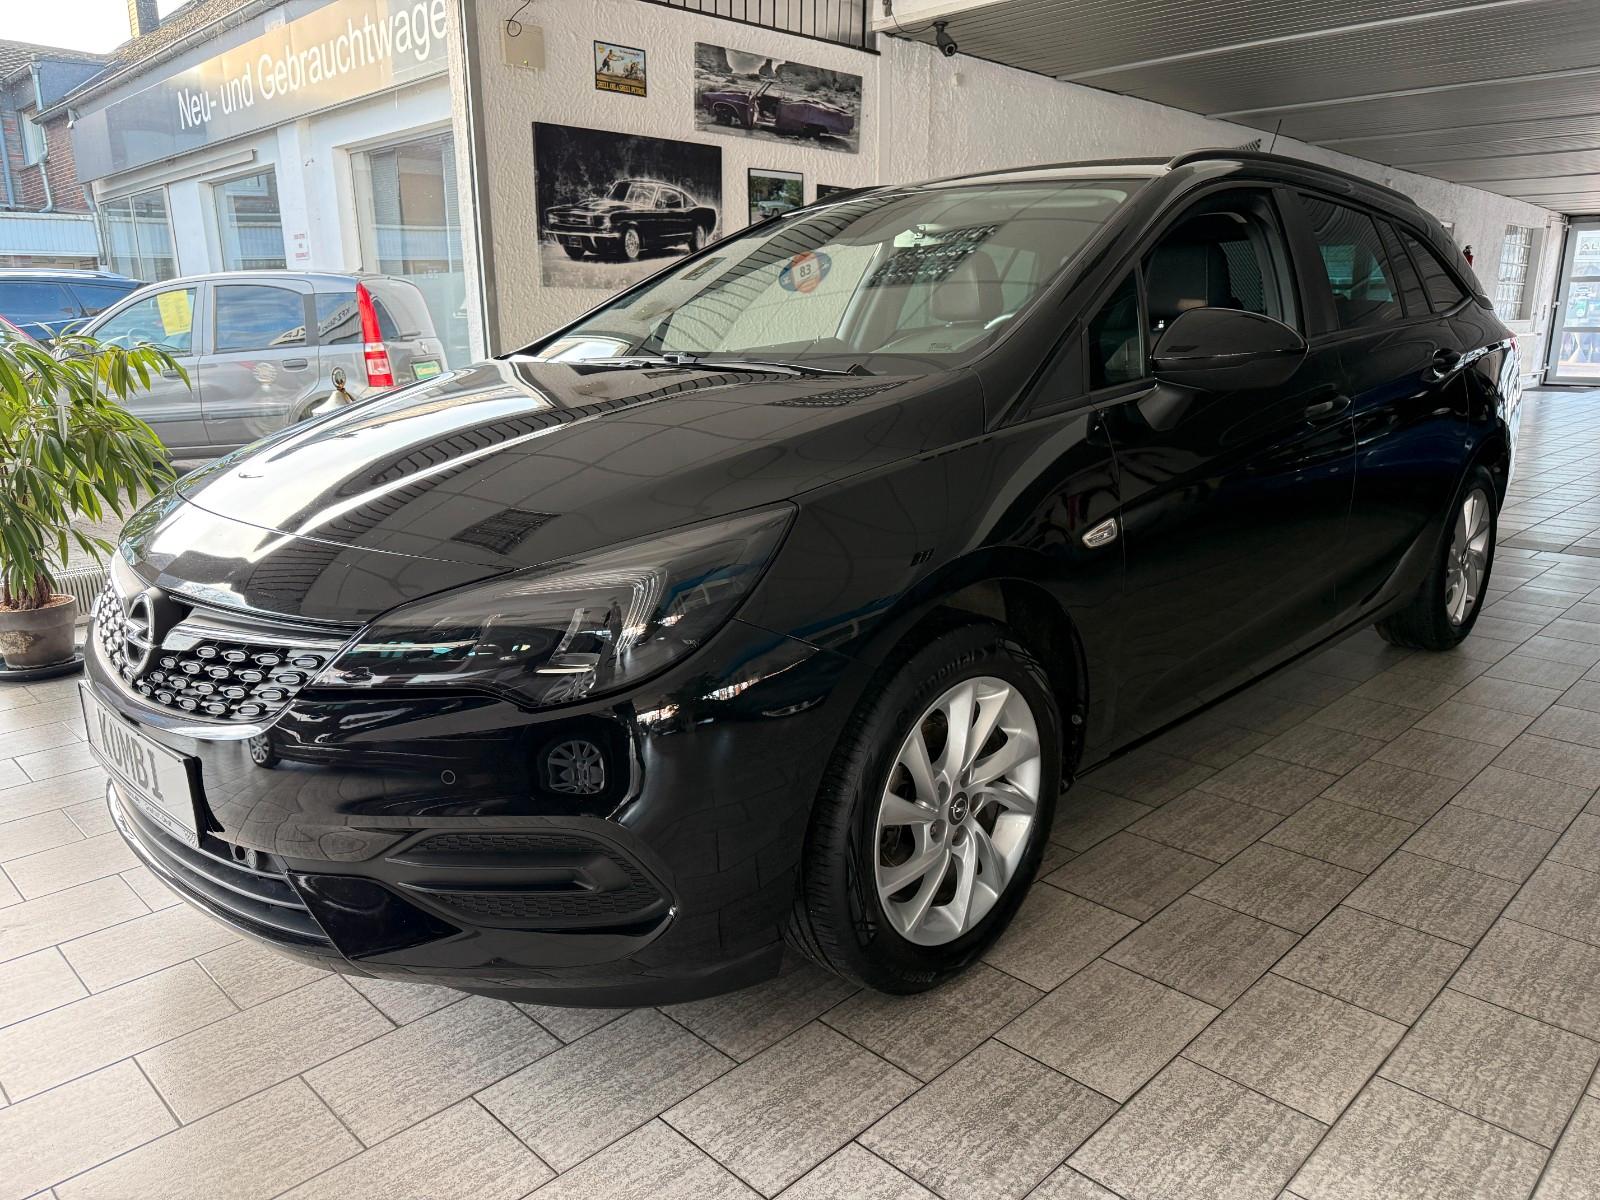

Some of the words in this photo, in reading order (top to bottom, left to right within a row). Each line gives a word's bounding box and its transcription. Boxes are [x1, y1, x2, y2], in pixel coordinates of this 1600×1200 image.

[177, 88, 217, 130] Neu-
[220, 64, 254, 115] und
[799, 264, 812, 277] 83
[97, 708, 164, 802] KOMBI
